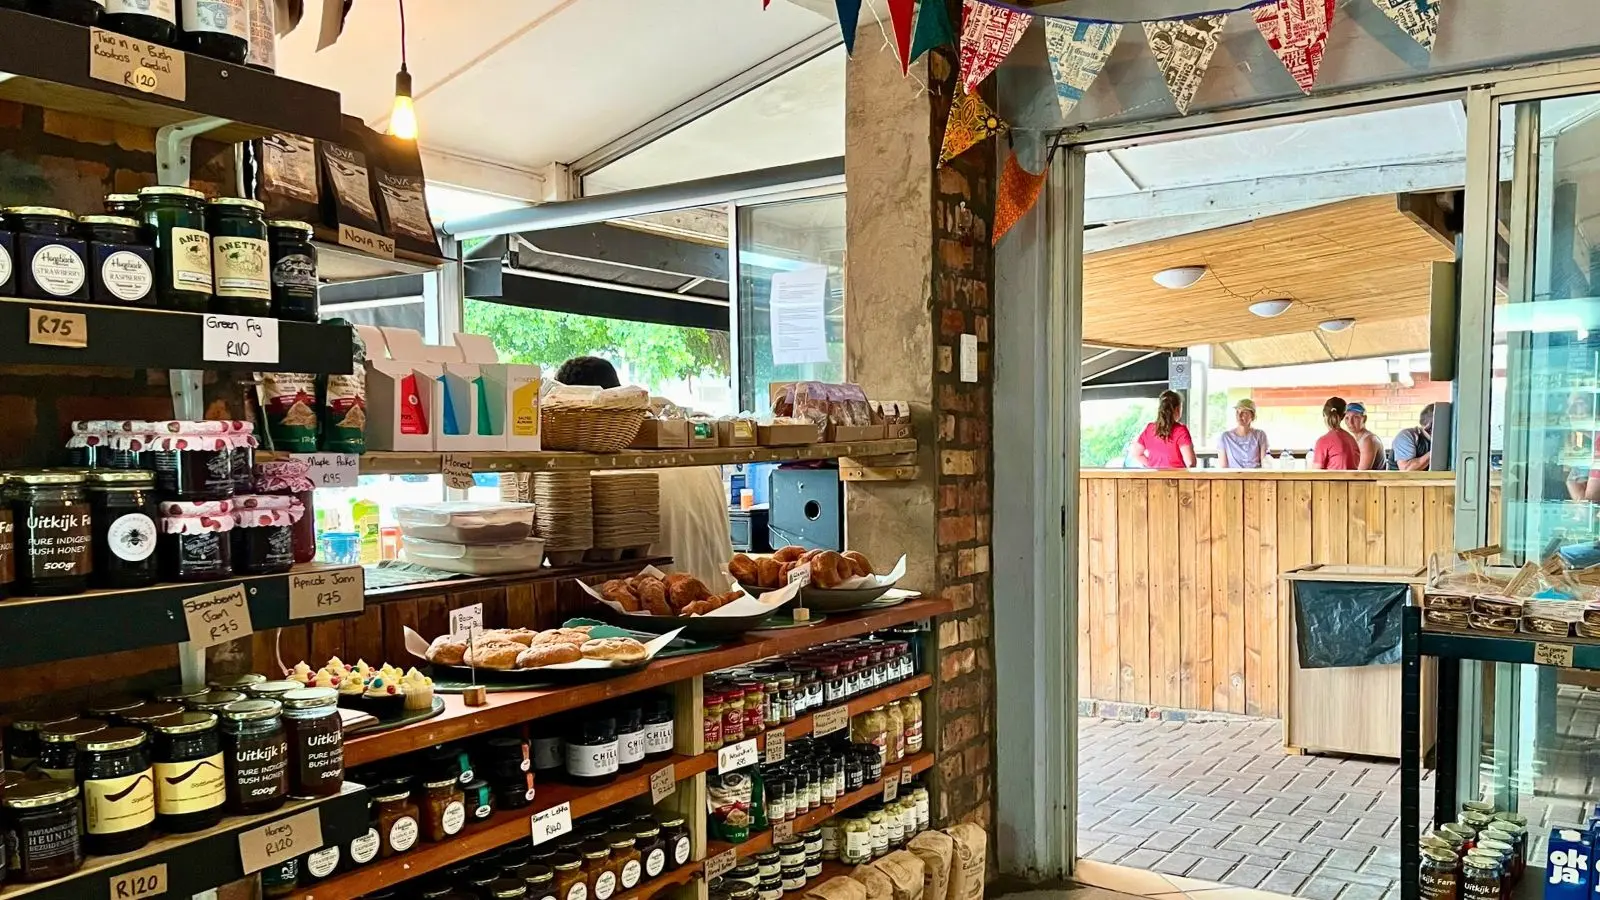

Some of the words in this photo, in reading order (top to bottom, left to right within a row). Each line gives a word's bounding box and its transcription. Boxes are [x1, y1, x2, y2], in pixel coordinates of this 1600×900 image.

[93, 30, 116, 45] Two
[132, 43, 140, 53] a
[147, 44, 173, 62] Bush
[140, 57, 171, 73] Cordial
[124, 71, 156, 88] R120
[344, 229, 374, 249] NOVA
[110, 274, 147, 283] RASPBERRY
[37, 315, 73, 336] R75
[206, 316, 239, 329] Green
[247, 318, 263, 337] Fig
[227, 341, 250, 358] R110
[27, 514, 78, 532] Uitkijk
[28, 538, 54, 546] PURE
[28, 548, 55, 556] BUSH
[57, 545, 86, 555] HONEY
[44, 561, 77, 571] 500gr
[317, 590, 342, 607] R75
[202, 608, 229, 623] Jam
[210, 620, 239, 640] R75
[308, 731, 342, 747] Uitkijk
[237, 745, 279, 762] Uitkijk
[308, 752, 328, 760] PURE
[238, 768, 259, 776] PURE
[308, 760, 329, 769] BUSH
[238, 776, 260, 785] BUSH
[262, 769, 284, 781] HONEY
[251, 785, 278, 797] 500gr
[265, 825, 293, 837] Honey
[265, 838, 293, 857] R120
[1550, 848, 1588, 871] ok
[1549, 865, 1580, 885] ja
[116, 875, 158, 899] R120
[1464, 882, 1490, 895] Uitkijk
